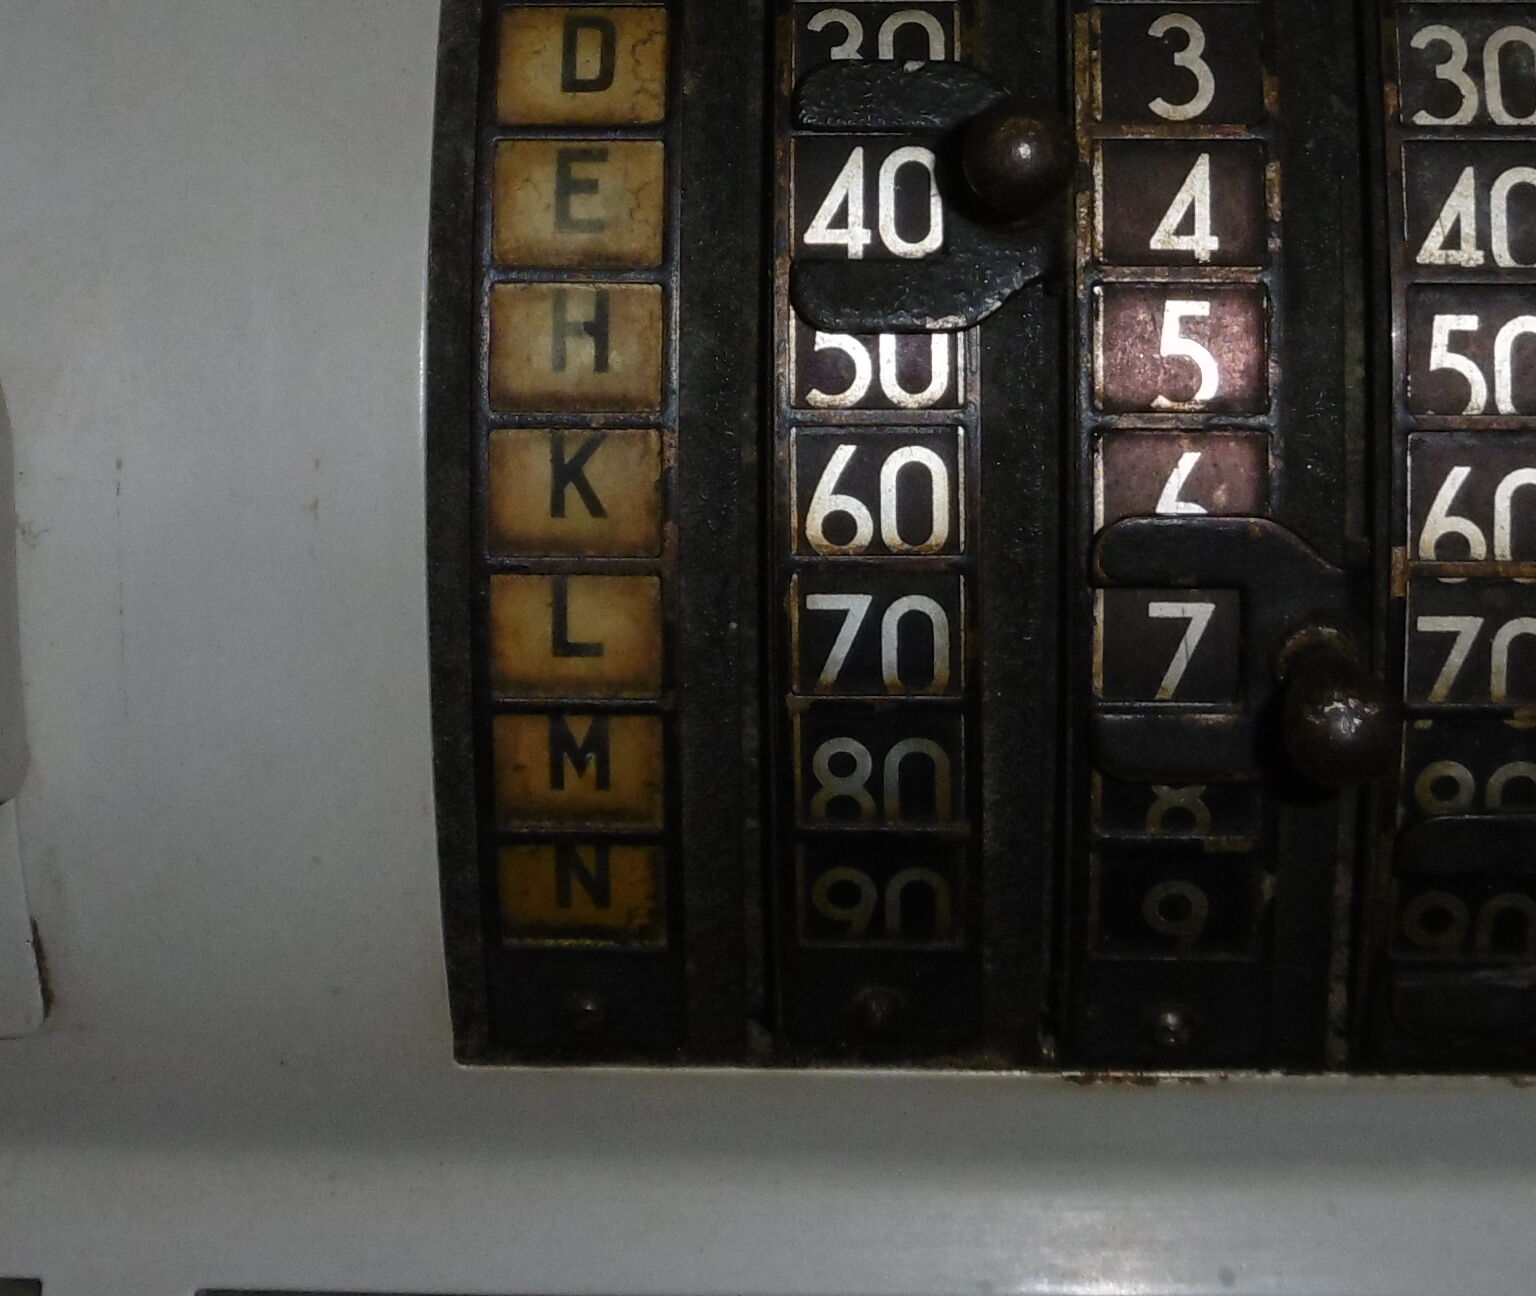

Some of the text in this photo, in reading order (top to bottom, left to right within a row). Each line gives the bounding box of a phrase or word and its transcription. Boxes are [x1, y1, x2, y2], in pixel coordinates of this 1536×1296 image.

[560, 16, 617, 94] D
[1146, 12, 1216, 121] 3
[552, 147, 610, 235] E
[803, 145, 944, 260] 40
[1148, 152, 1220, 263] 4
[552, 289, 610, 374] H
[806, 333, 949, 409] 50
[1150, 300, 1220, 410] 5
[549, 431, 609, 519] K
[805, 443, 950, 555] 60
[552, 576, 604, 658] L
[806, 594, 950, 694] 70
[1147, 601, 1216, 701] 7
[549, 715, 611, 790] M
[810, 735, 953, 825] 80
[555, 843, 612, 909] N
[810, 865, 953, 940] 90
[1142, 878, 1210, 953] 9
